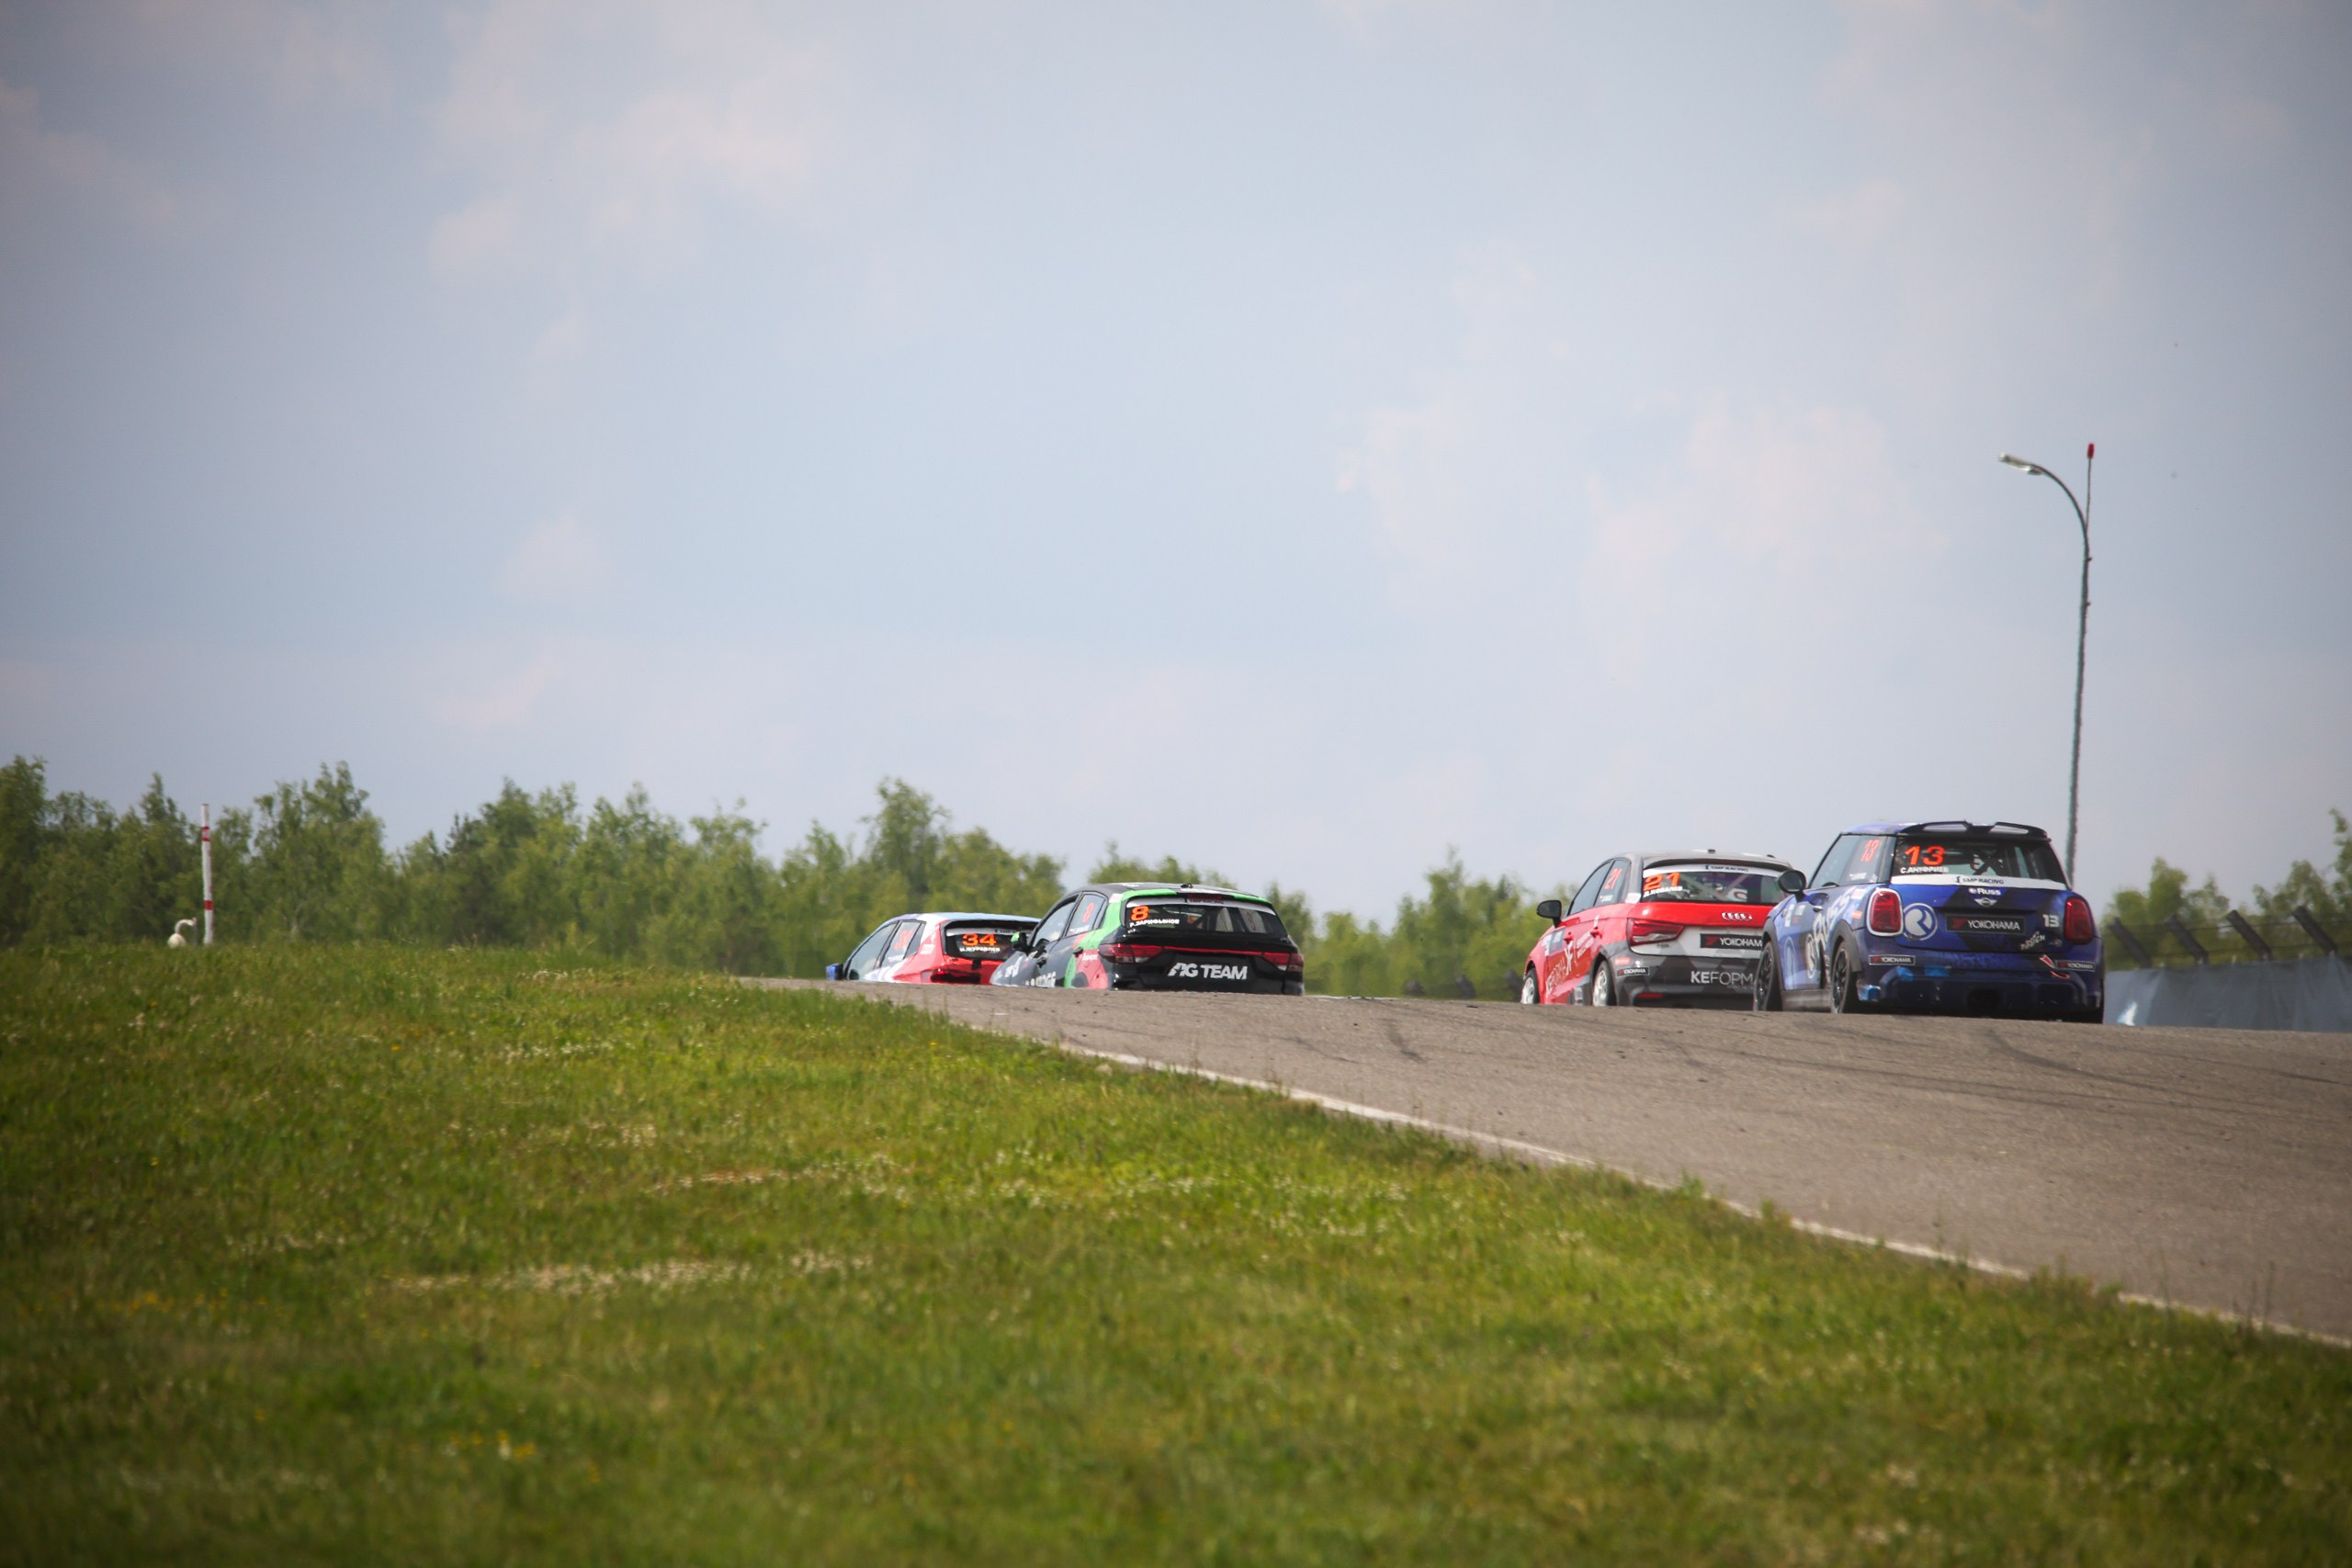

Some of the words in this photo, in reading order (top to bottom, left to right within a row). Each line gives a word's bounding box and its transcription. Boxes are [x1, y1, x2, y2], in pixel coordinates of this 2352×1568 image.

[1860, 839, 1881, 862] 13
[1905, 845, 1946, 865] 13
[1604, 868, 1623, 890] 21
[1643, 872, 1680, 892] 21
[1131, 905, 1149, 921] 8
[2042, 914, 2060, 928] 13
[1967, 919, 2020, 931] YOKOHAMA
[962, 933, 997, 946] 34
[1719, 937, 1763, 947] YOKOHAM
[1200, 964, 1248, 980] TEAM
